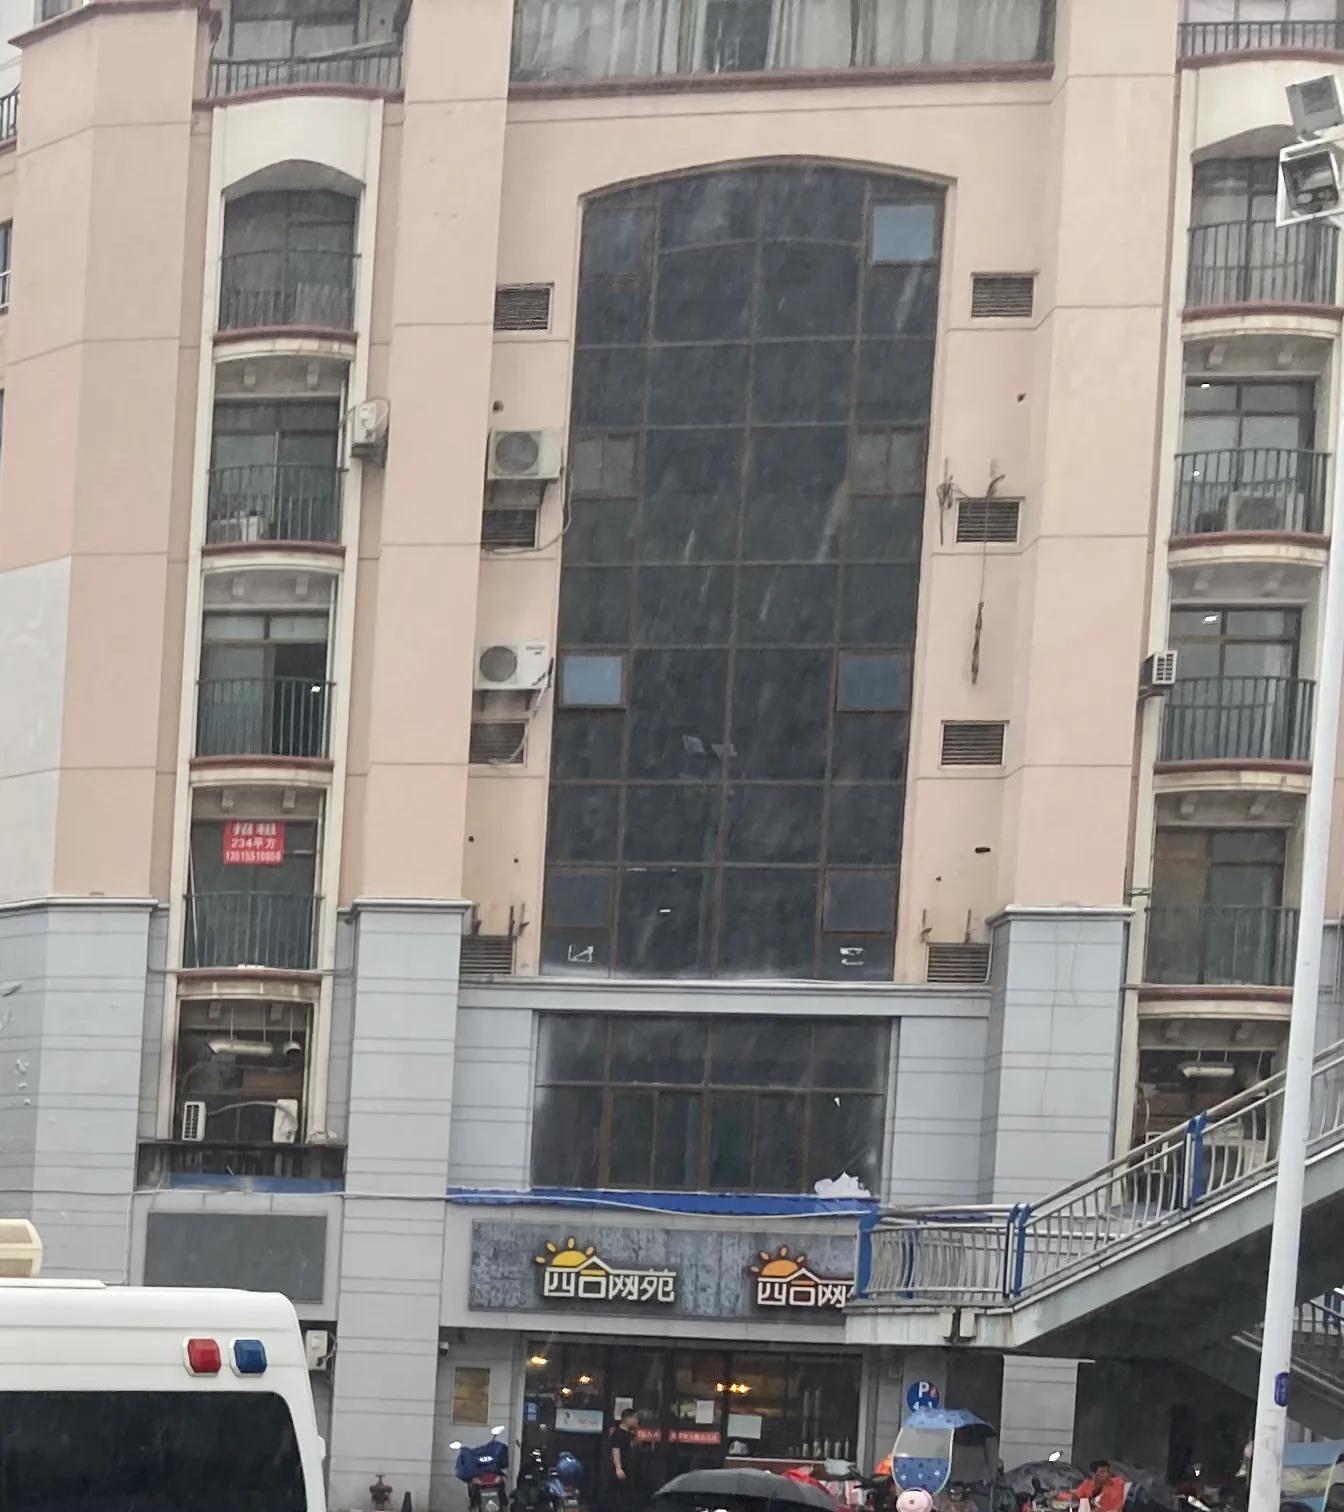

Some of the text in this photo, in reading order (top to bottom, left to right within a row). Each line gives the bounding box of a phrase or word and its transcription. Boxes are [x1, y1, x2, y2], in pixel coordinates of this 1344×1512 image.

[232, 822, 277, 836] 招租
[756, 1267, 856, 1309] 四合网
[918, 1381, 930, 1399] P
